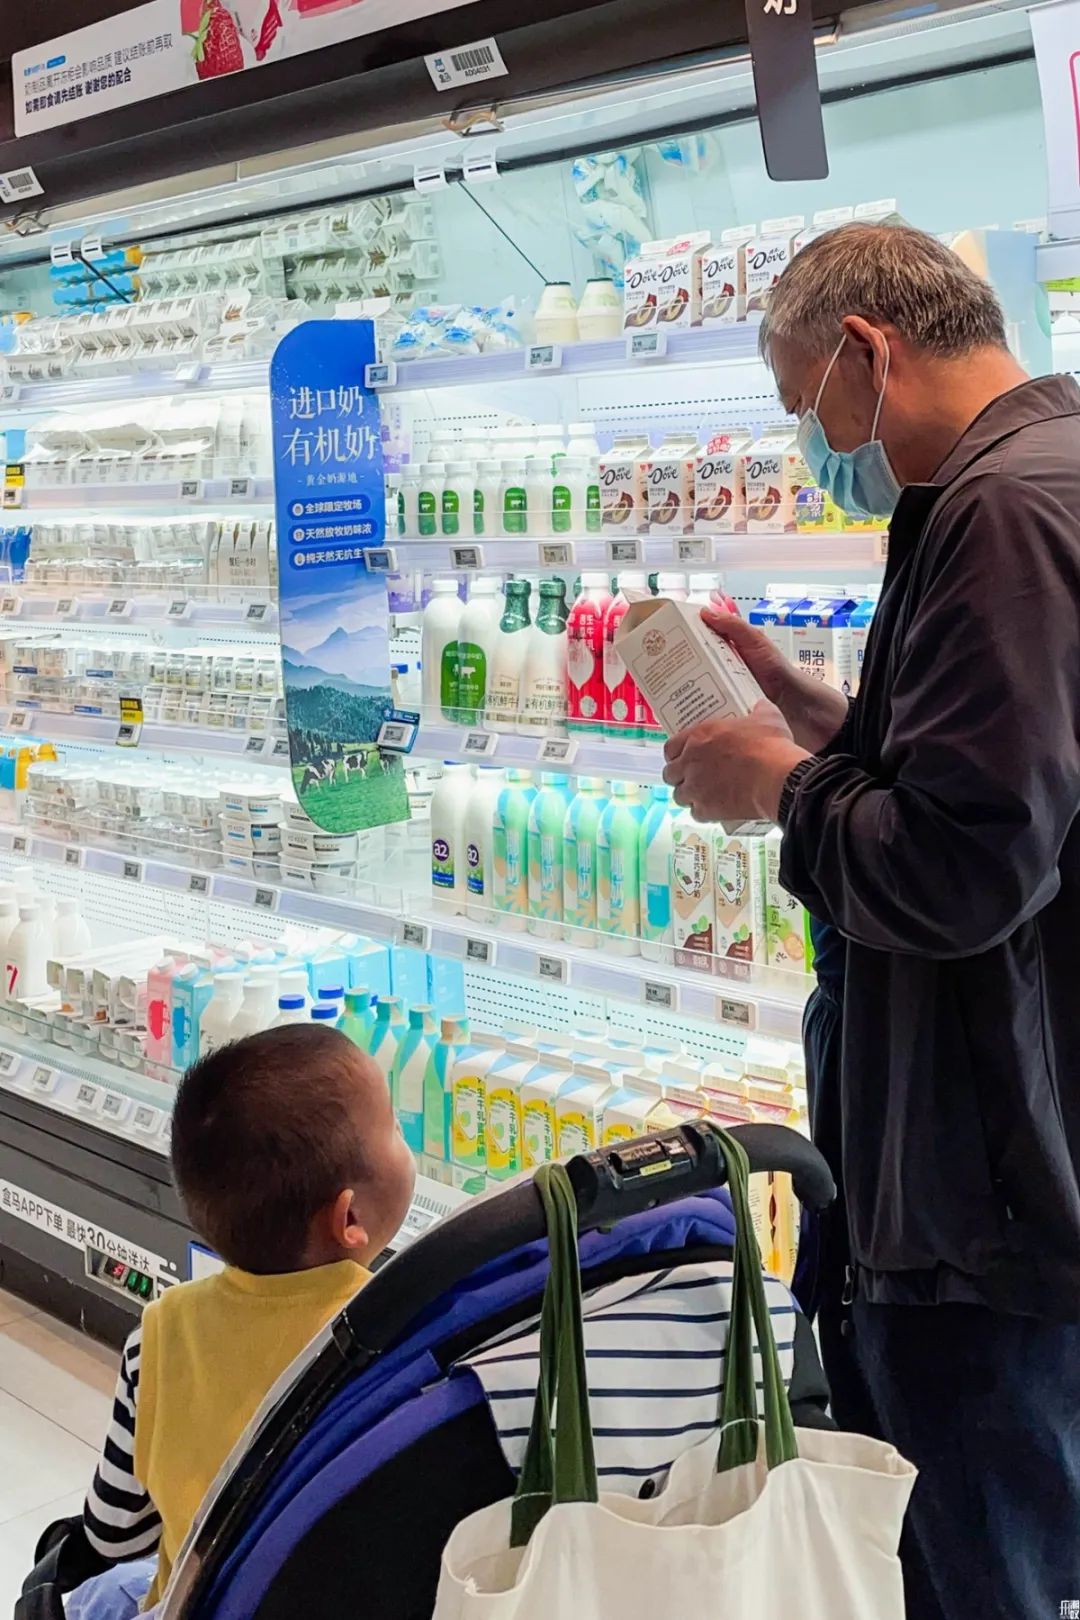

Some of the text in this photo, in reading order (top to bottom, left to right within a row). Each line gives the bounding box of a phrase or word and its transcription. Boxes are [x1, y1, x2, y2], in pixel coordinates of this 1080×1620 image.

[85, 66, 132, 95] 谢谢您的配合
[704, 256, 735, 278] Dove
[748, 249, 787, 270] Dove
[626, 269, 658, 289] Dove
[658, 263, 690, 283] Dove
[289, 385, 363, 419] 进口奶
[281, 424, 377, 466] 有机奶
[600, 469, 632, 486] Dove
[648, 467, 679, 485] Dove
[697, 461, 732, 480] Dove
[747, 461, 780, 479] Dove
[305, 500, 362, 514] 全球限定牧场
[306, 523, 372, 540] 天然放牧奶味浓
[799, 649, 825, 666] 明治
[434, 843, 448, 858] a2
[467, 848, 478, 863] a2
[2, 1187, 151, 1272] 盒马APP下单 最快30分钟送达
